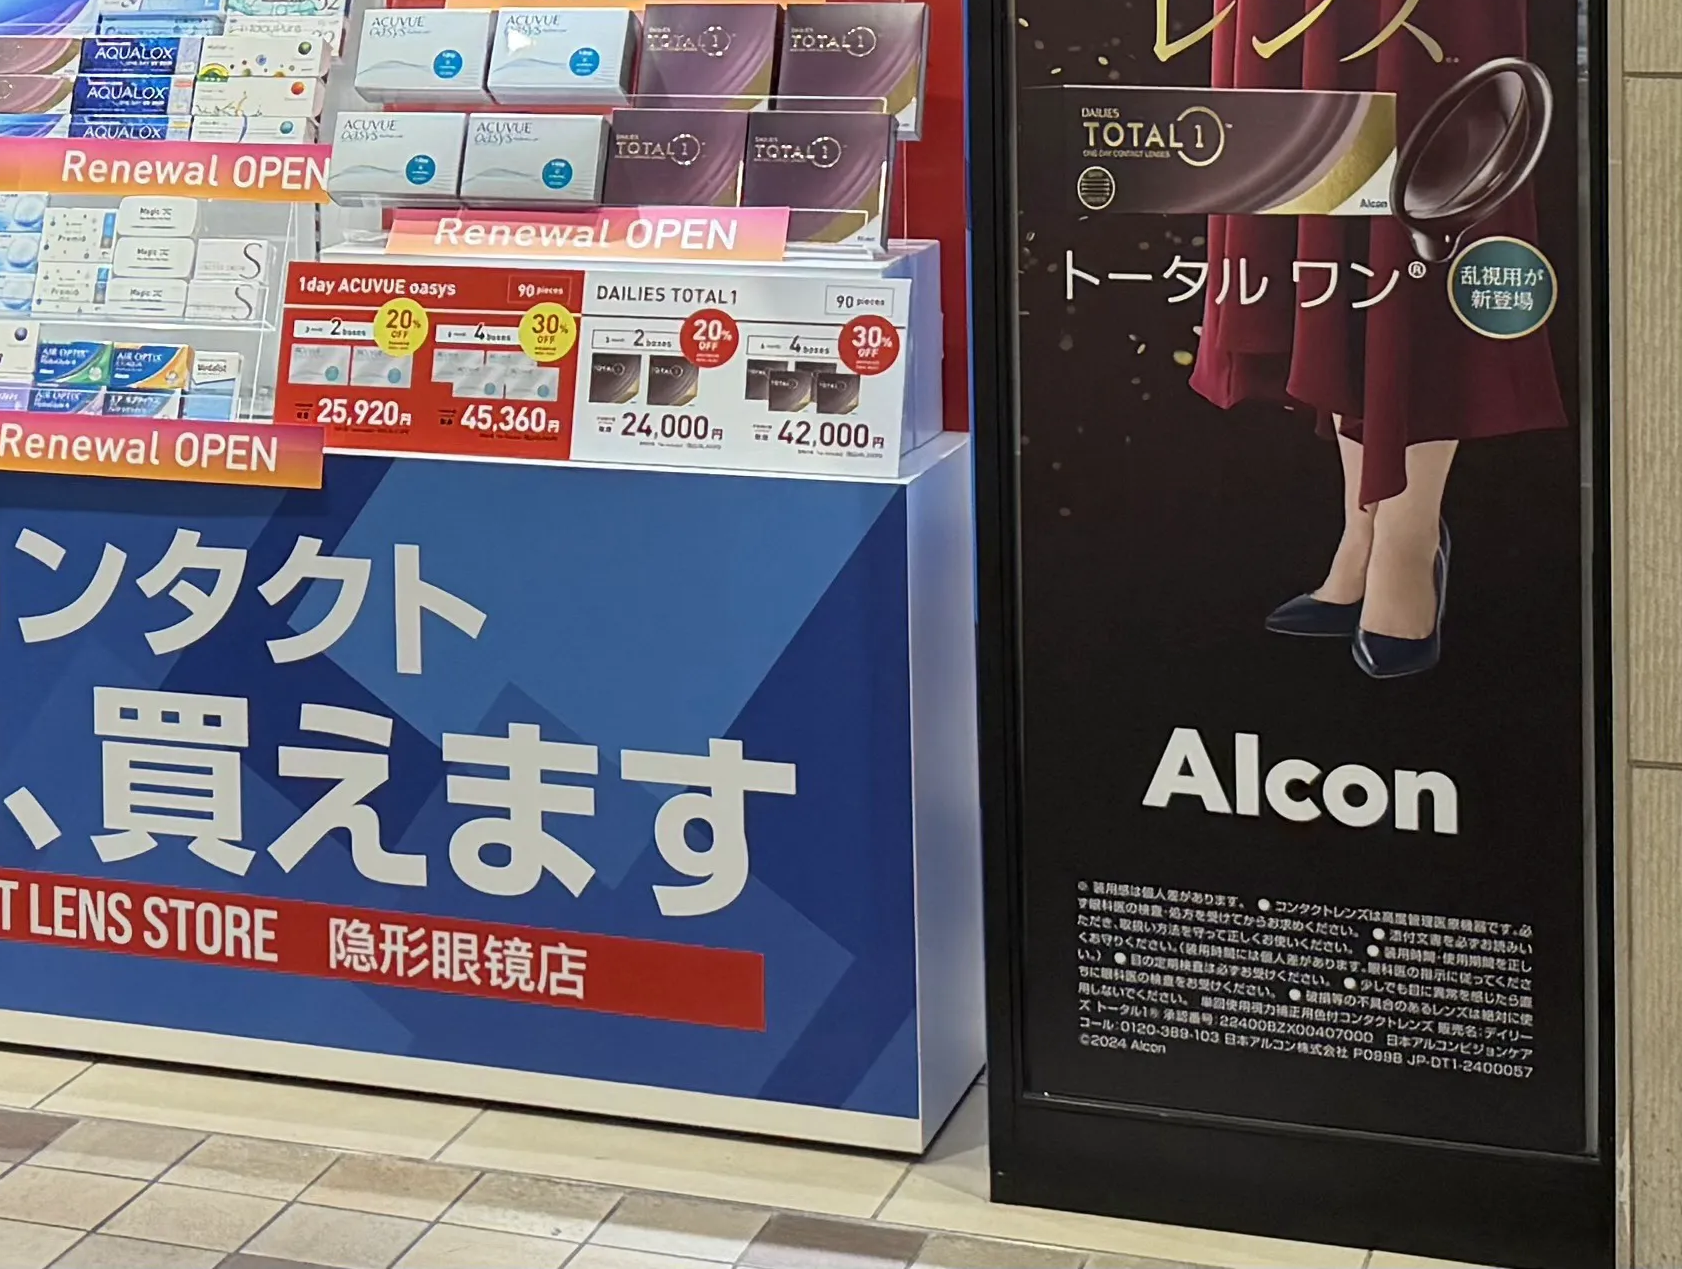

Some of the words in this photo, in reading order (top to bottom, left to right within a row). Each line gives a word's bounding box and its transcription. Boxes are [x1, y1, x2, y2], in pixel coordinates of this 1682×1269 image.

[370, 16, 426, 28] ACUVUE
[505, 15, 560, 27] ACUVUE
[94, 46, 174, 61] AQUALOX
[86, 86, 165, 100] AQUALOX
[343, 119, 398, 132] ACUVUE
[476, 122, 533, 135] ACUVUE
[60, 149, 219, 188] Renewal
[232, 155, 332, 192] OPEN
[433, 217, 611, 249] Renewal
[625, 218, 738, 251] OPEN
[299, 276, 335, 295] 1day
[338, 279, 405, 294] ACUVUE
[409, 282, 456, 298] oasys
[518, 284, 536, 298] 90
[1064, 249, 1268, 308] トータル
[1460, 265, 1544, 288] 乱視用が
[597, 285, 666, 303] DAILIES
[673, 287, 738, 305] TOTAL1
[836, 295, 854, 309] 90
[1470, 289, 1534, 312] 新登場
[386, 309, 422, 330] 20%
[532, 313, 569, 335] 30%
[693, 319, 732, 342] 20%
[634, 329, 644, 347] 2
[699, 341, 718, 352] OFF
[852, 326, 893, 349] 30%
[858, 348, 879, 359] OFF
[317, 397, 412, 427] 25,920円
[460, 404, 560, 434] 45,360円
[621, 412, 723, 440] 24,000円
[777, 419, 885, 449] 42,000円
[174, 431, 278, 473] OPEN
[1142, 727, 1459, 835] Alcon
[29, 883, 134, 946] LENS
[143, 896, 280, 964] STORE
[327, 919, 588, 1000] 隐形眼镜店
[1130, 1040, 1167, 1055] Alcon
